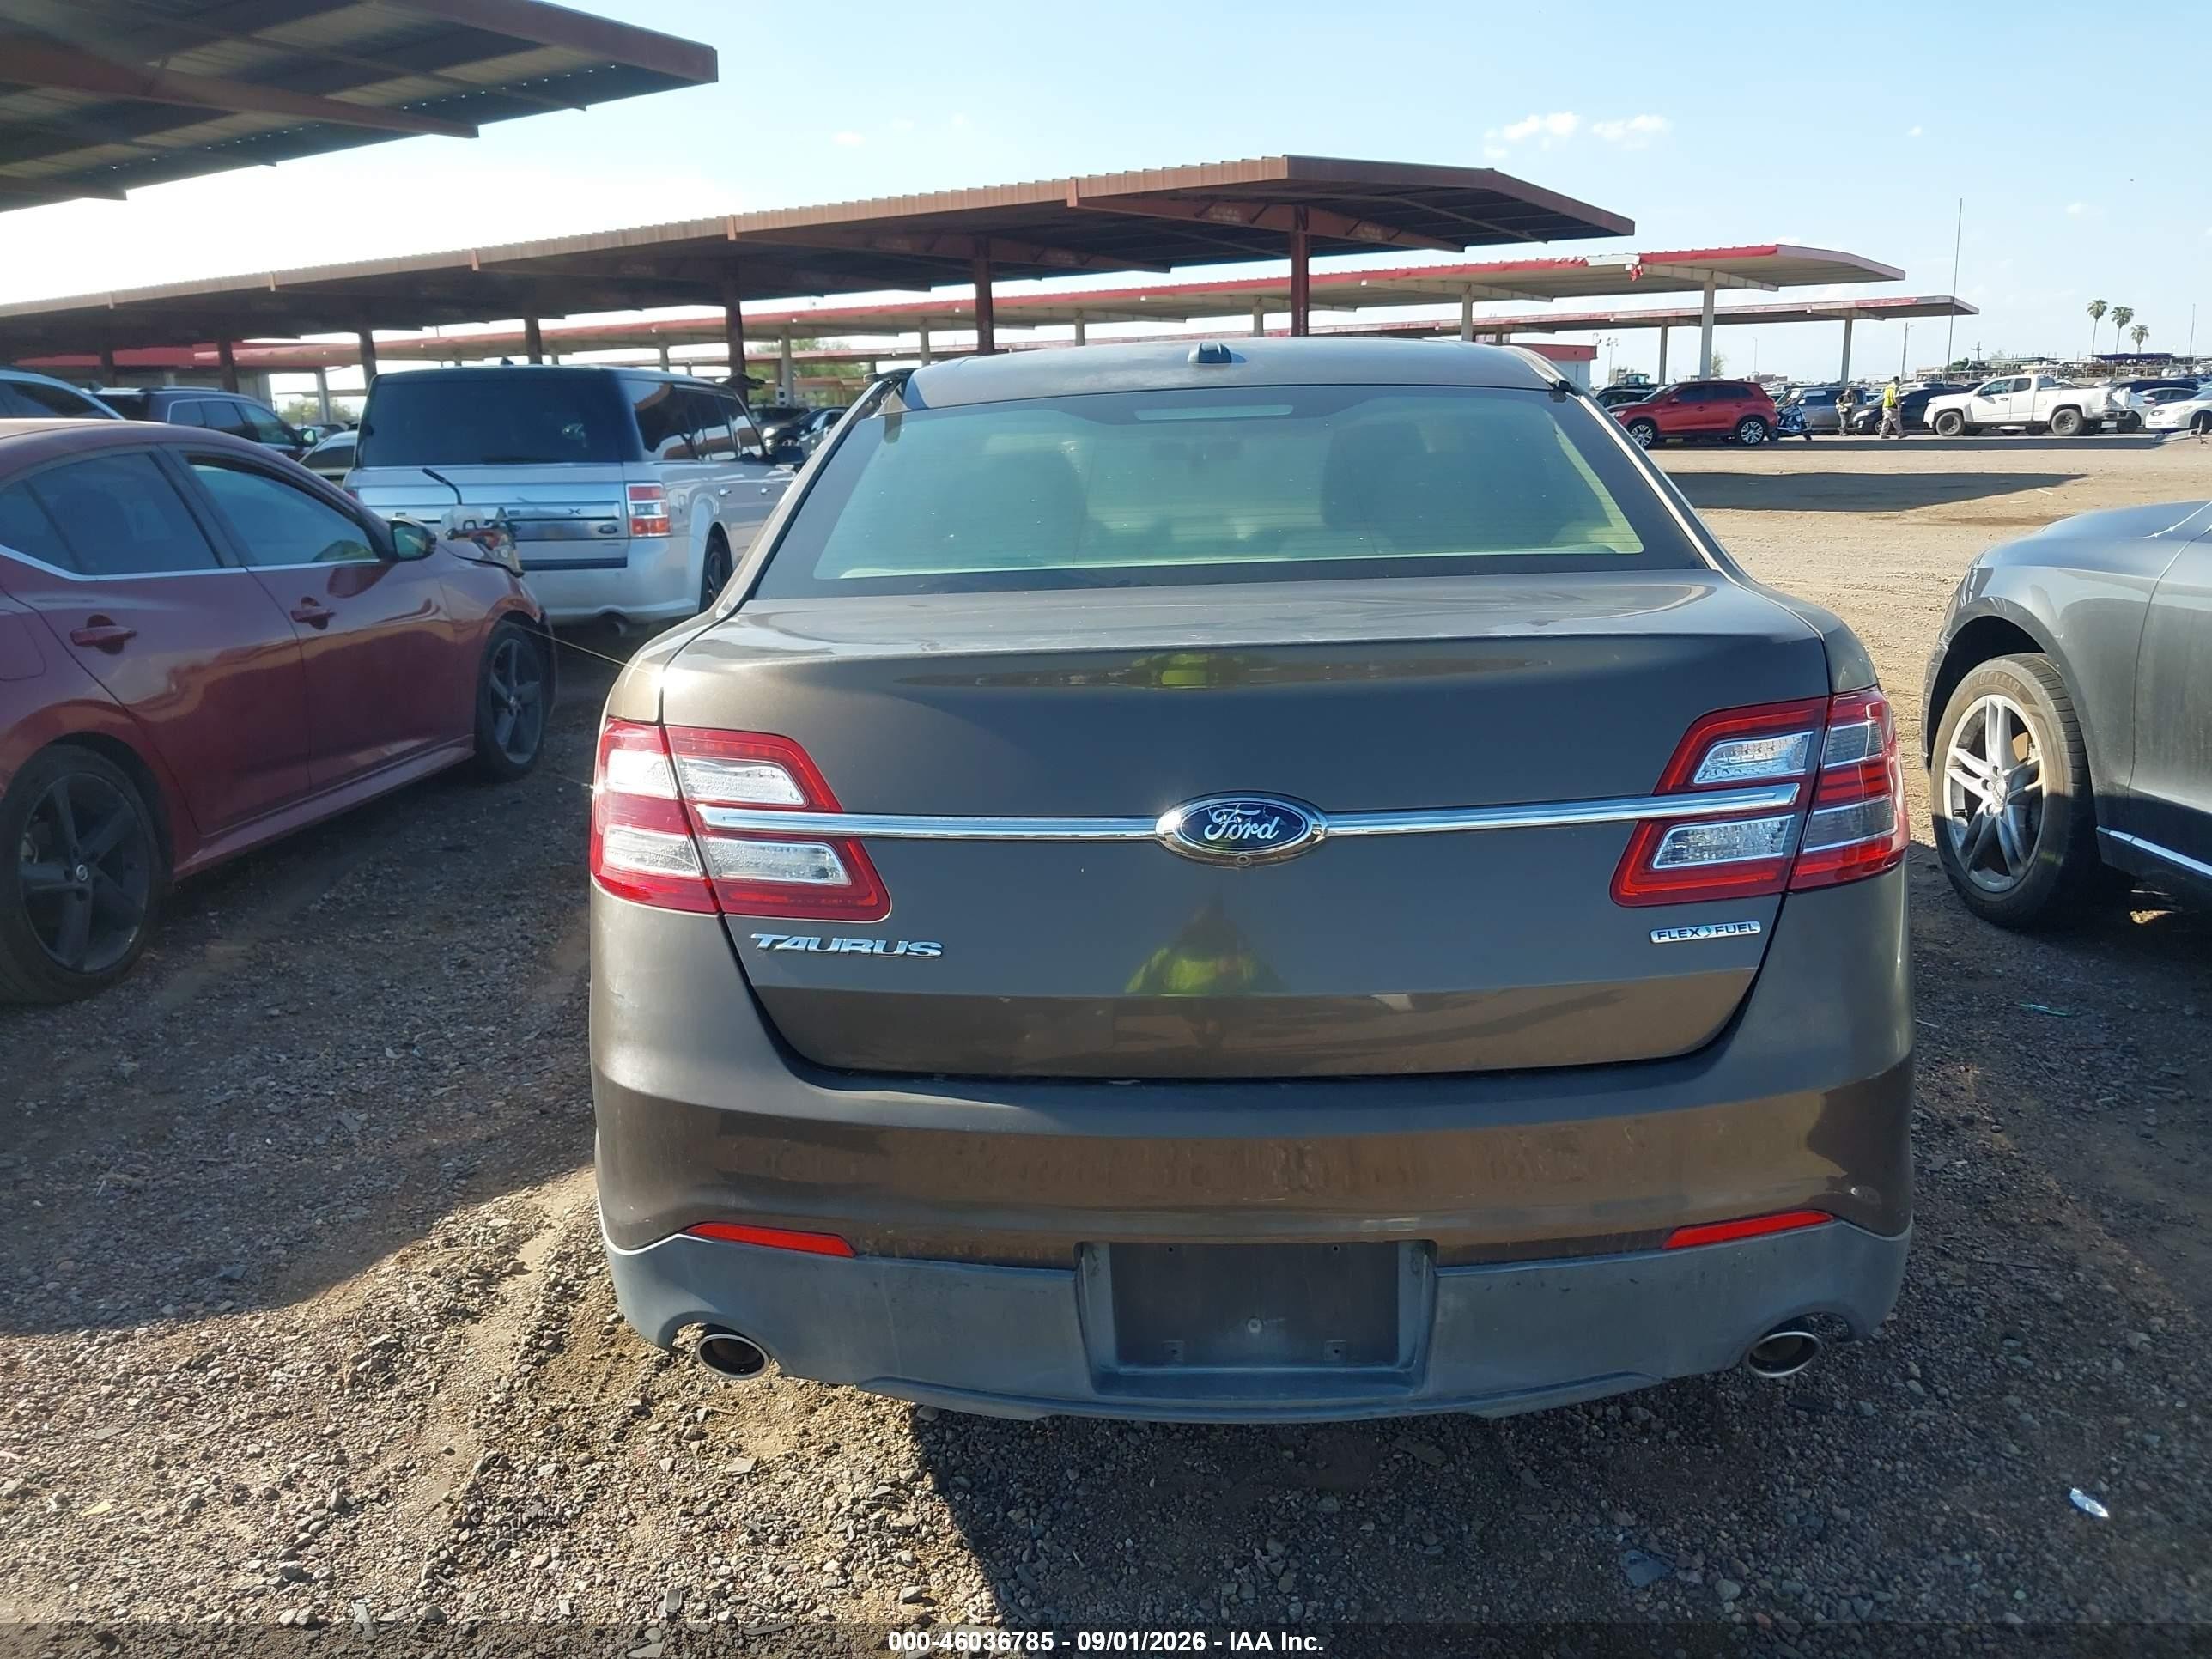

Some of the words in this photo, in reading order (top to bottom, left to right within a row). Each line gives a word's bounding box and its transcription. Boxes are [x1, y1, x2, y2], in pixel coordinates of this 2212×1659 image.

[1204, 808, 1280, 840] Ford
[1657, 927, 1701, 940] FLEX
[1715, 923, 1757, 935] FUEL
[750, 933, 942, 958] TAURUS
